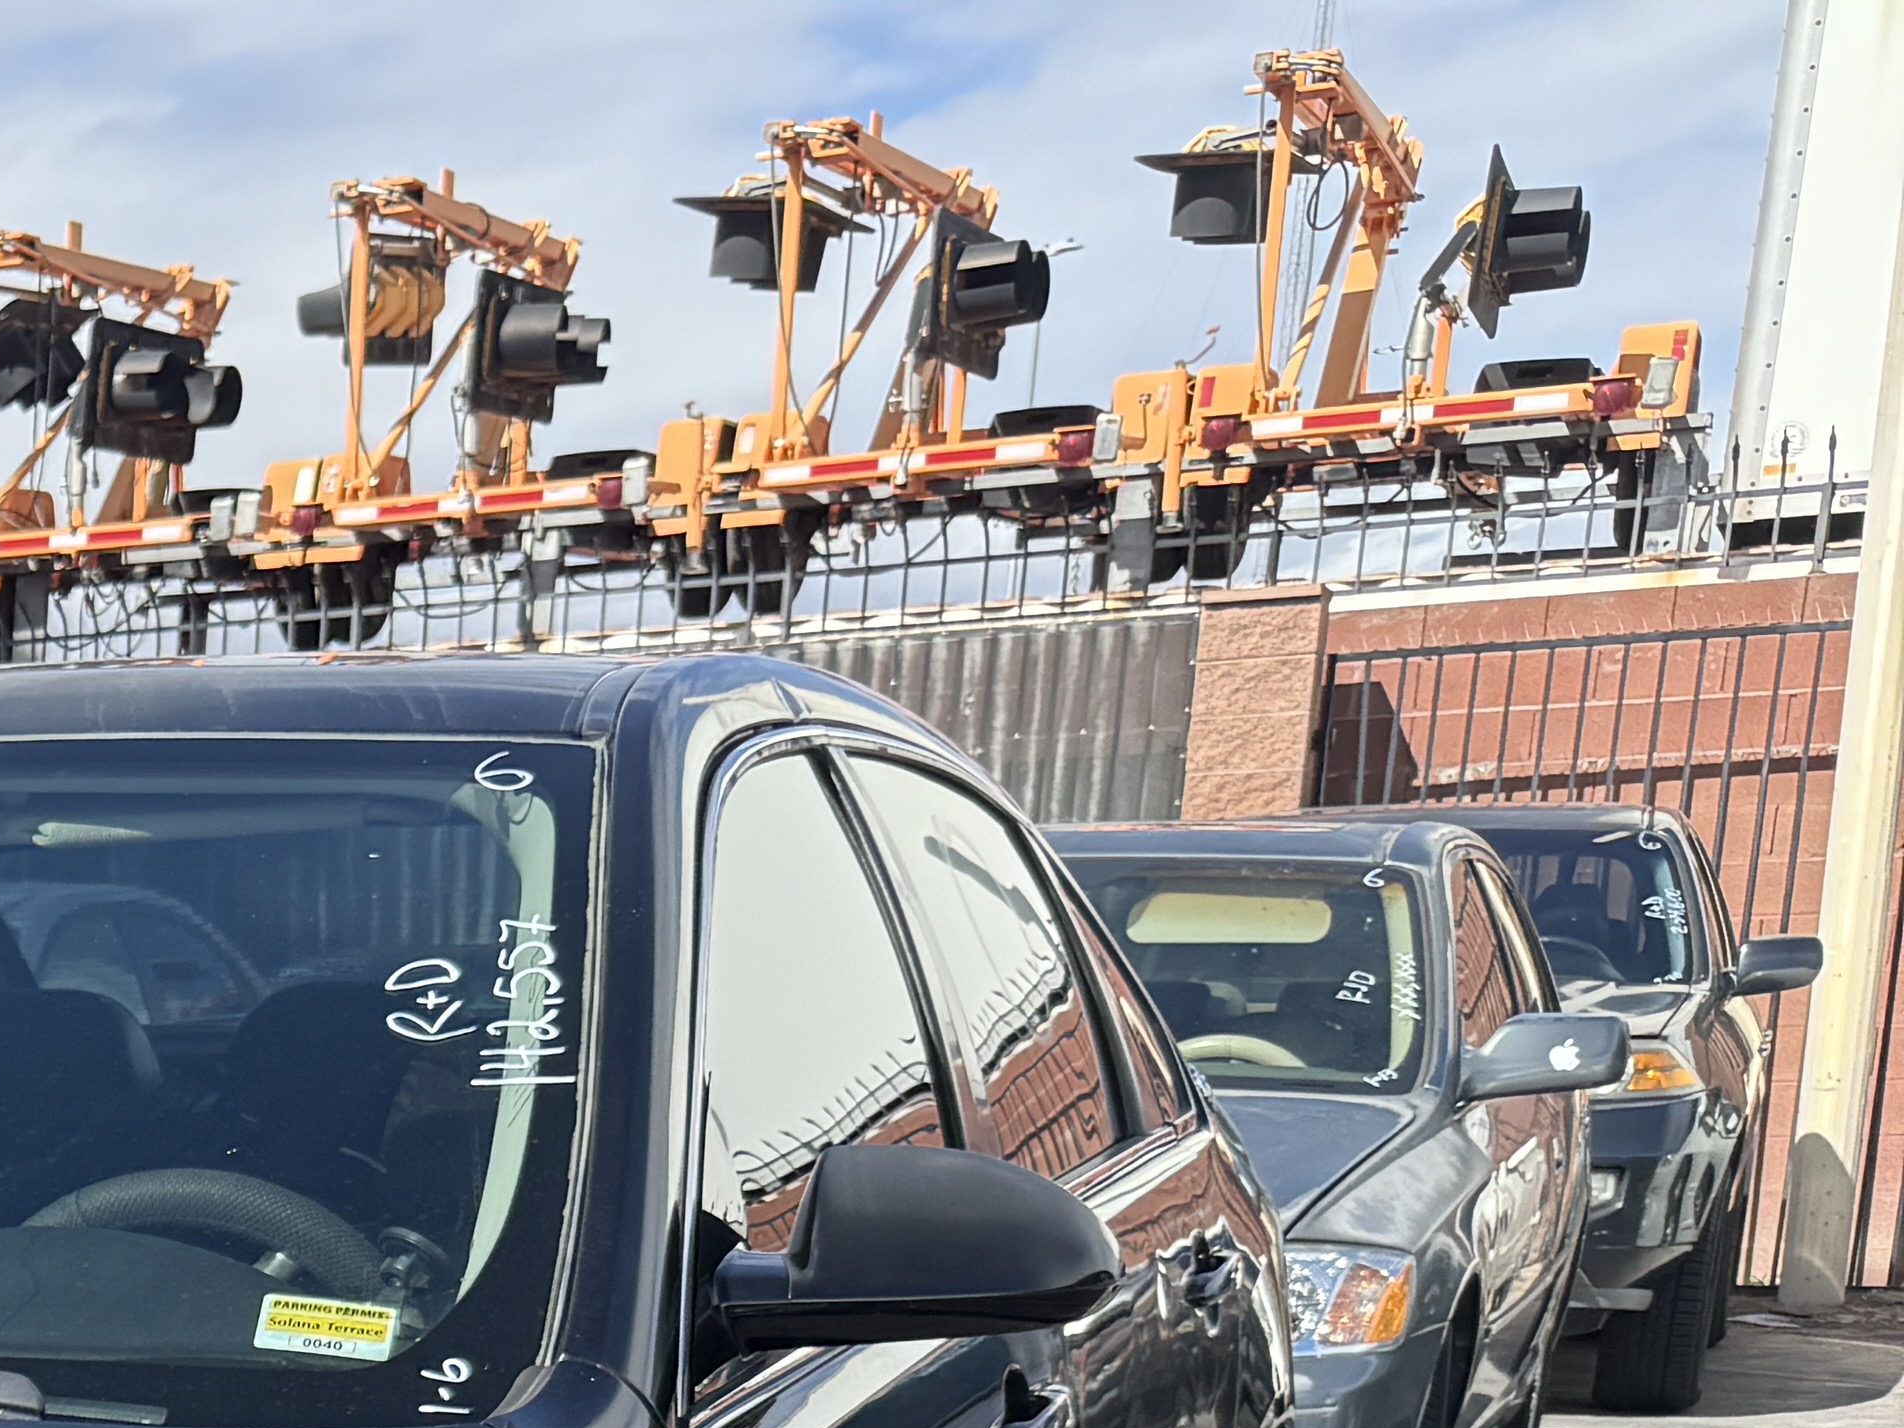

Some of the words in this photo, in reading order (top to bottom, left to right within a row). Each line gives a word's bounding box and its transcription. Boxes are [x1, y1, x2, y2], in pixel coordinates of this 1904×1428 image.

[474, 751, 536, 792] 6
[1363, 867, 1385, 888] 6
[385, 958, 478, 1042] R+D
[272, 1299, 333, 1315] PARKING
[268, 1316, 321, 1330] Solana
[328, 1321, 384, 1337] Terrace
[302, 1337, 343, 1351] 0040
